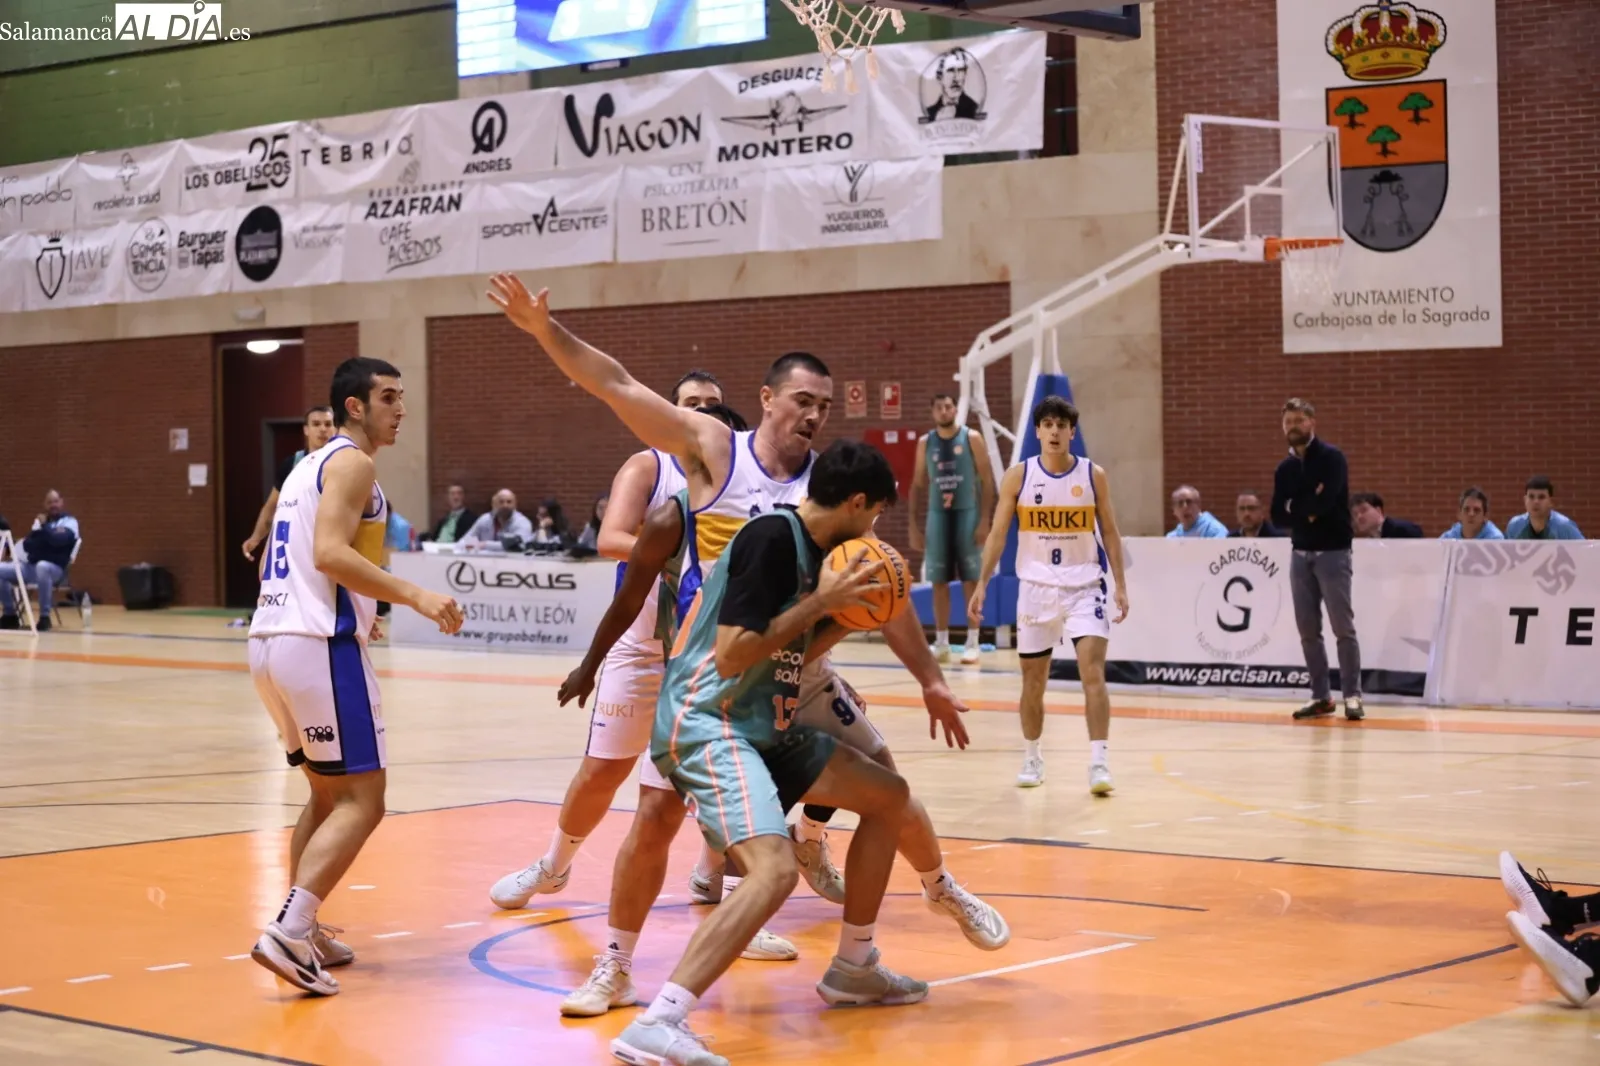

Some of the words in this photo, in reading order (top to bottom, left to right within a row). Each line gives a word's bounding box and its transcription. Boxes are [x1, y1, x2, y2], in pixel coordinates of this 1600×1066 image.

[564, 92, 702, 158] VIAGON
[301, 134, 414, 167] TEBRIO
[717, 132, 853, 162] MONTERO
[185, 173, 210, 190] LOS
[214, 160, 291, 185] OBELISCOS
[364, 193, 463, 220] AZAFRAN
[641, 197, 747, 233] BRETÓN
[826, 208, 886, 223] YUGUEROS
[481, 222, 532, 239] SPORT
[548, 214, 608, 234] CENTER
[178, 230, 228, 250] Burguer
[191, 248, 225, 270] Tapas
[1293, 312, 1373, 331] Carbajosa
[1377, 313, 1397, 326] de
[1402, 309, 1417, 325] la
[1422, 305, 1491, 327] Sagrada
[1028, 511, 1087, 532] IRUKI
[1051, 548, 1062, 565] 8
[1209, 547, 1280, 579] GARCISAN
[480, 570, 577, 590] LEXUS
[461, 603, 518, 622] ASTILLA
[521, 605, 532, 622] Y
[535, 602, 577, 625] LEÓN
[1145, 664, 1311, 686] www.garcisan.es
[831, 697, 856, 727] 9
[304, 725, 335, 743] 1988
